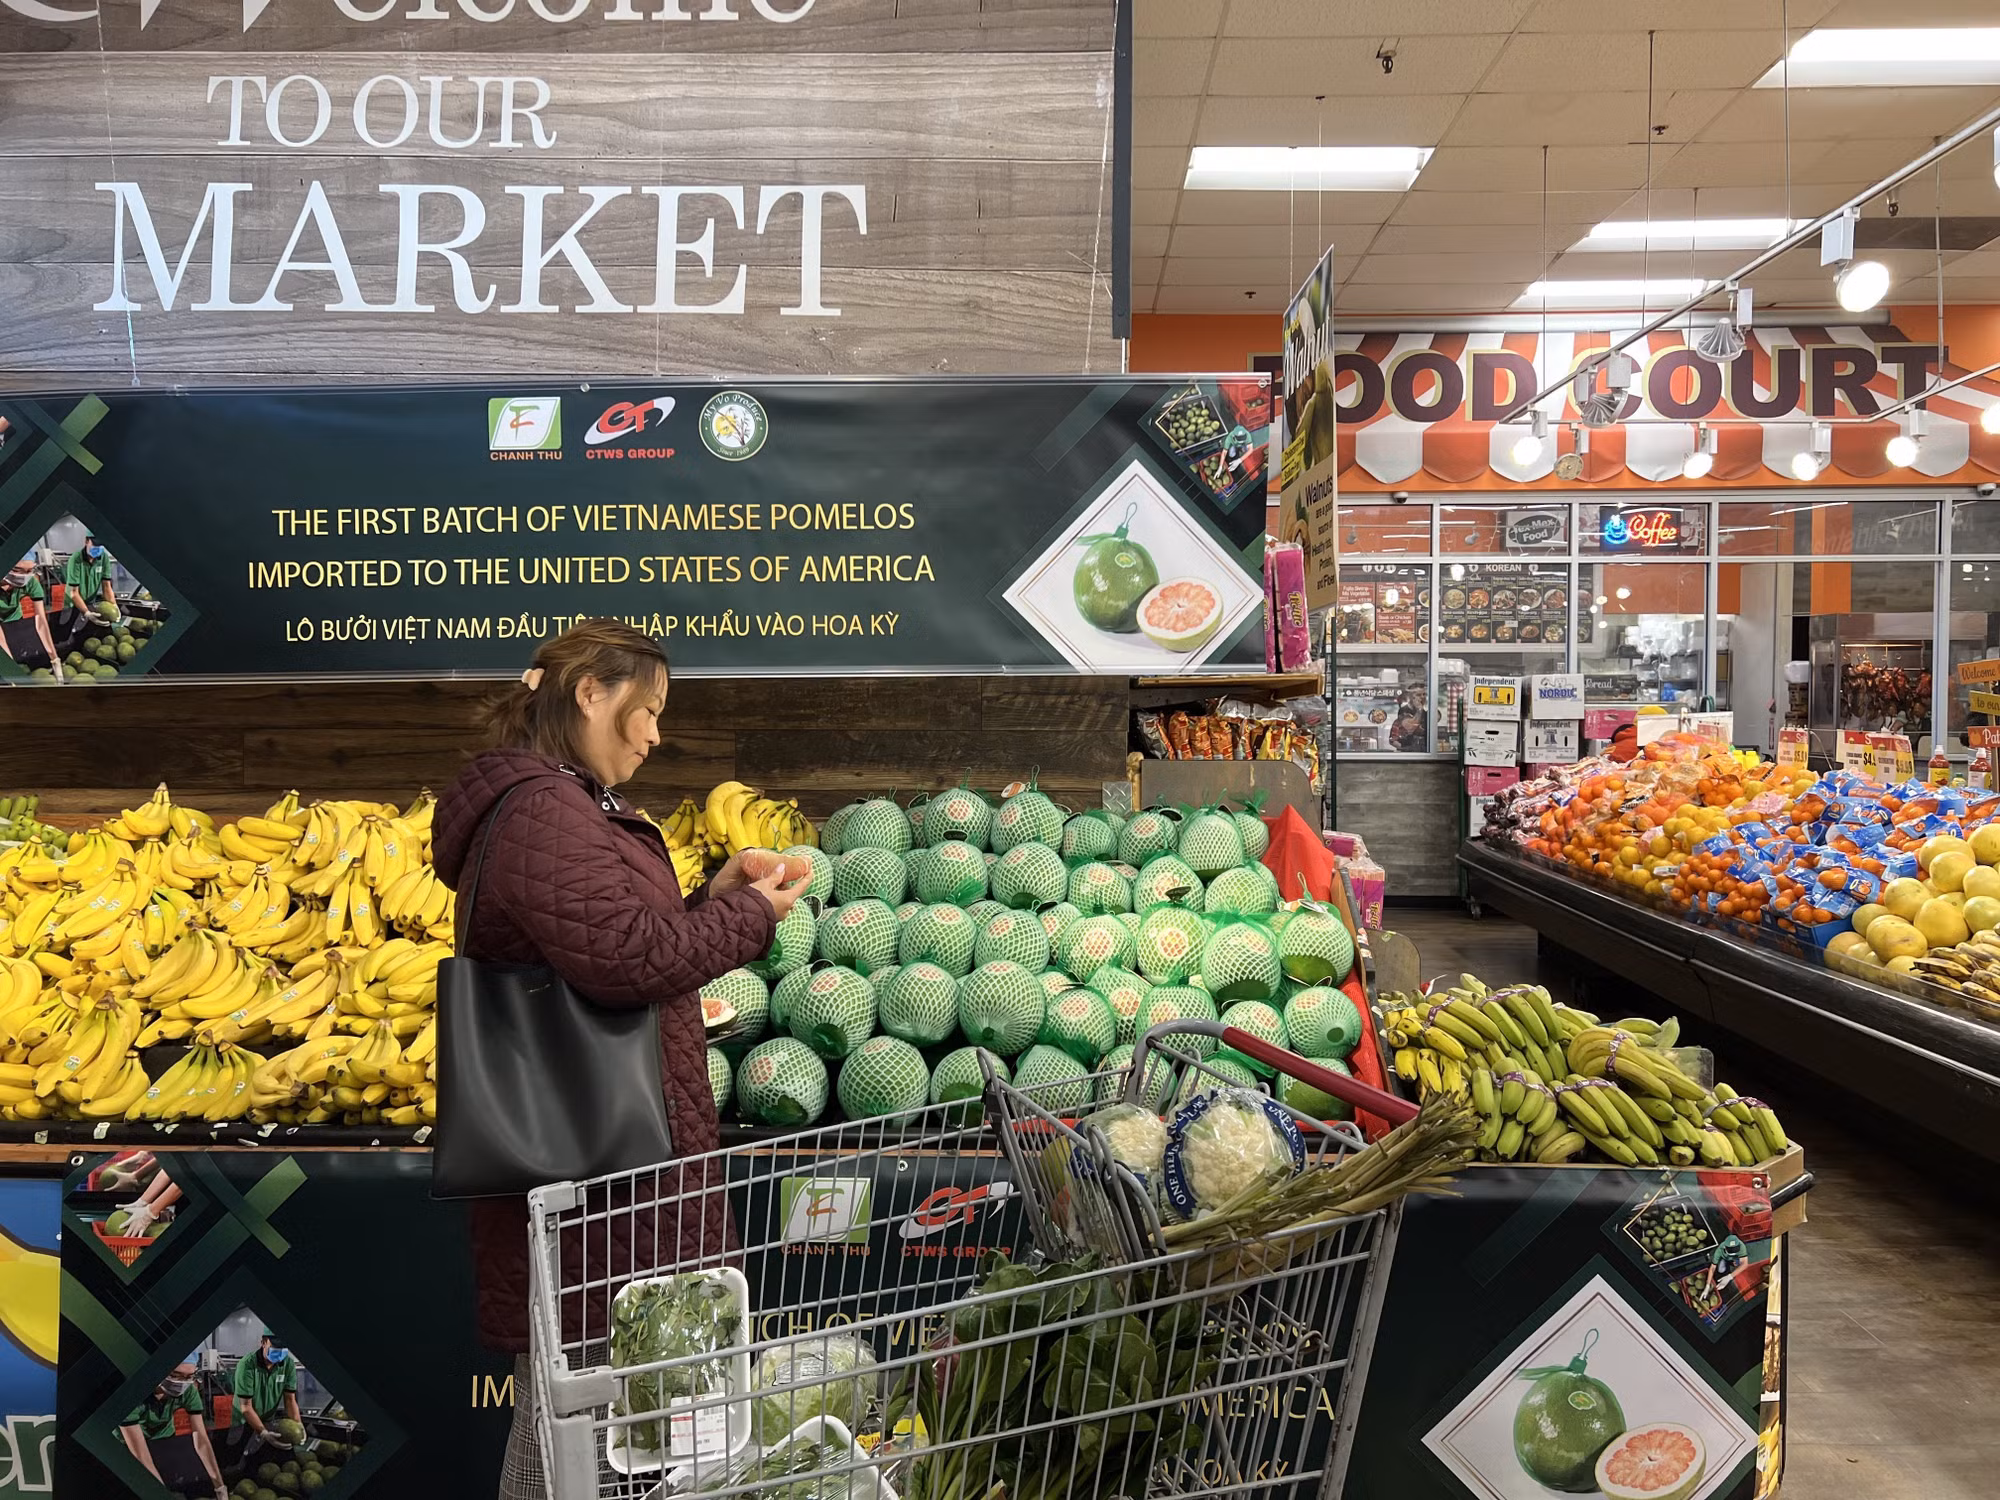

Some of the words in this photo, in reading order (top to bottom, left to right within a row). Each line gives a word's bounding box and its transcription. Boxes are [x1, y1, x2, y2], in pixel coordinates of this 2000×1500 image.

[206, 74, 332, 149] TO
[353, 74, 558, 150] OUR
[93, 180, 867, 316] MARKET
[1572, 345, 1948, 422] COURT
[732, 394, 762, 421] Produce
[490, 450, 534, 460] CHANH
[538, 450, 563, 460] THU
[586, 449, 624, 459] CTWS
[627, 448, 675, 459] GROUP
[1305, 474, 1333, 507] Walnuts
[272, 510, 328, 536] THE
[338, 508, 416, 535] FIRST
[424, 507, 518, 534] BATCH
[527, 506, 566, 532] OF
[573, 504, 762, 531] VIETNAMESE
[771, 503, 915, 530] POMELOS
[1628, 512, 1677, 546] Coffee
[1522, 530, 1548, 542] Food
[248, 561, 402, 588] IMPORTED
[408, 560, 447, 586] TO
[454, 559, 510, 585] THE
[520, 557, 630, 584] UNITED
[639, 557, 742, 583] STATES
[750, 556, 790, 583] OF
[799, 555, 936, 582] AMERICA
[286, 617, 314, 642] LÔ
[322, 613, 377, 641] BƯỞI
[382, 615, 431, 644] VIỆT
[438, 617, 491, 639] NAM
[497, 611, 547, 639] ĐẦU
[686, 609, 750, 637] KHẨU
[756, 611, 805, 636] VÀO
[813, 614, 864, 636] HOA
[871, 611, 900, 636] KỲ
[1474, 677, 1516, 686] Independent
[1962, 667, 1997, 681] Welcome
[1538, 688, 1578, 699] NORDIC
[1169, 1178, 1186, 1205] ONE
[840, 1245, 871, 1257] THU
[901, 1245, 948, 1258] CTWS
